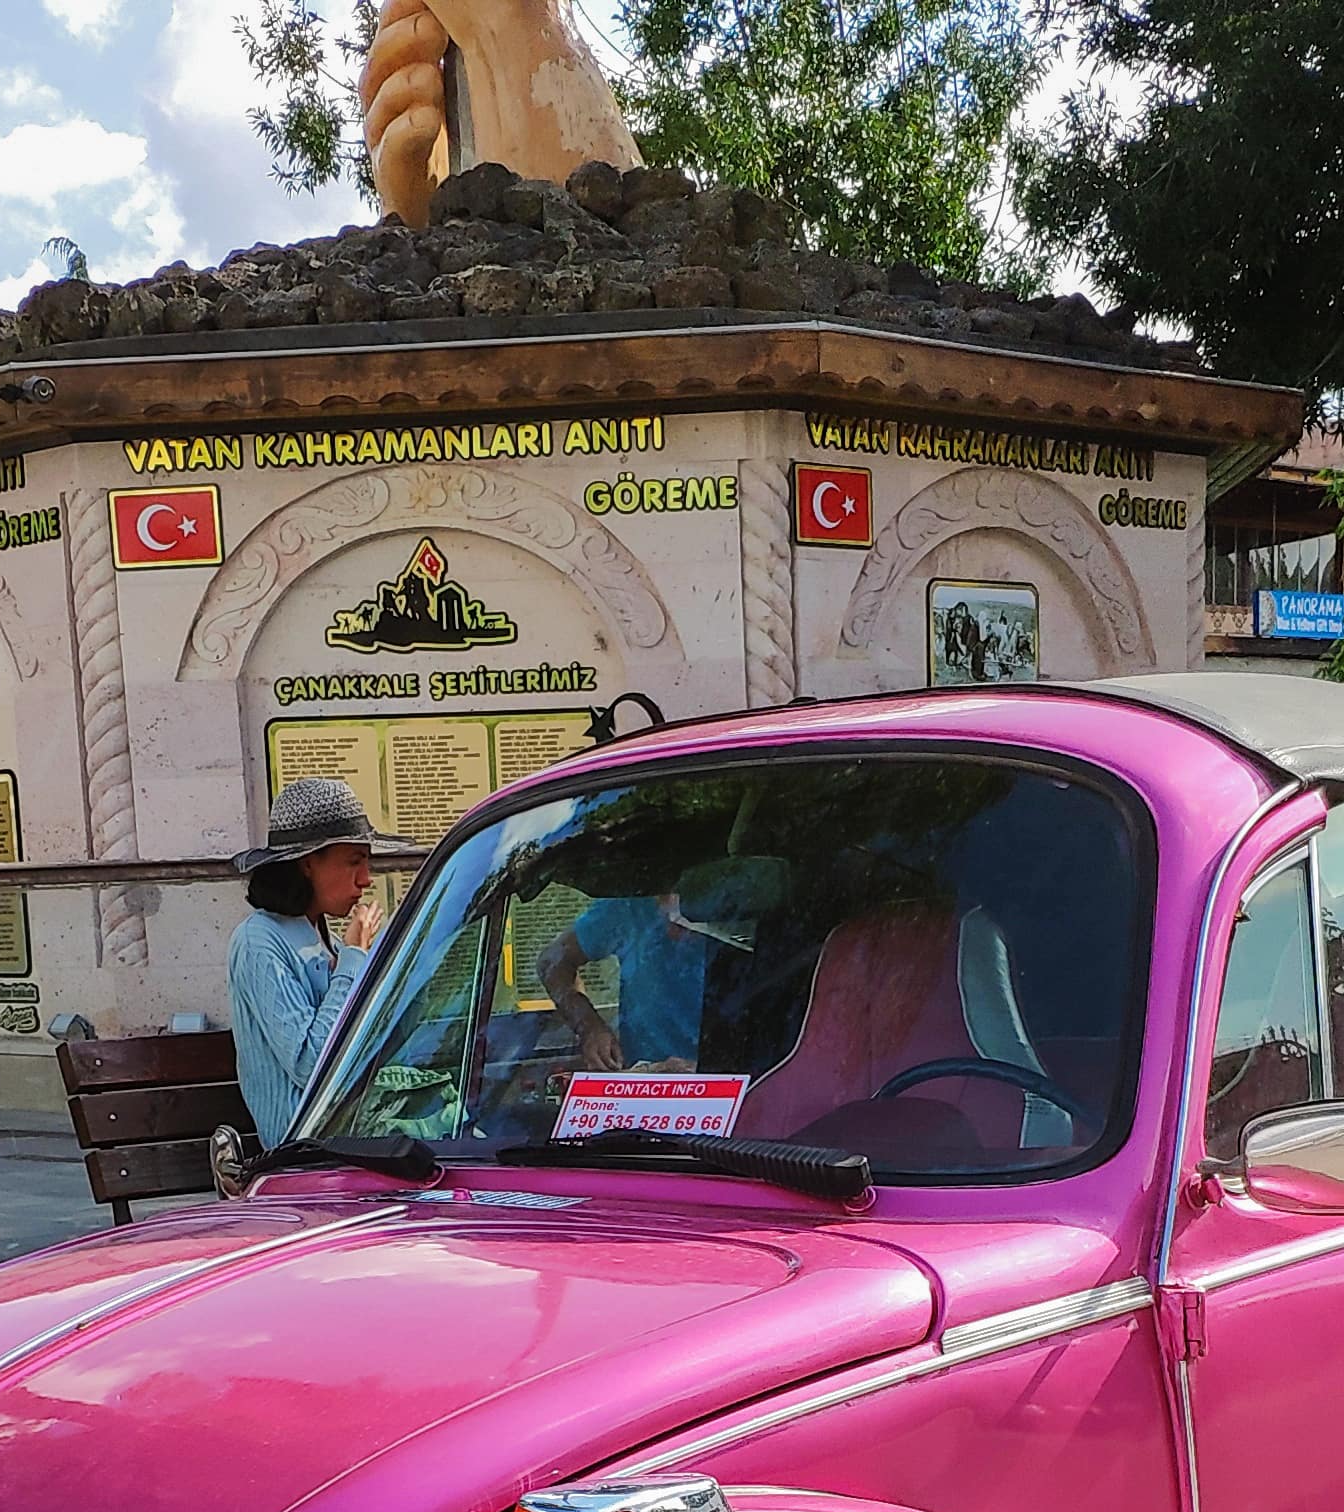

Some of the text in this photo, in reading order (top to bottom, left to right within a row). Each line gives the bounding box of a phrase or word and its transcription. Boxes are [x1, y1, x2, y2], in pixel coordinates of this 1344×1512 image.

[126, 416, 664, 473] VATAN KAHRAMANLARI ANITI
[806, 412, 1154, 481] VATAN KAHRAMANLARI ANITI
[584, 472, 737, 515] GÖREME
[1098, 488, 1187, 530] GÖREME
[1281, 595, 1342, 617] PANORAMA
[274, 662, 597, 705] ÇANAKKALE ŞEHİTLERİMİZ
[573, 1099, 619, 1112] Phone:
[604, 1082, 707, 1096] CONTACT INFO
[568, 1114, 723, 1130] +90 535 528 69 66
